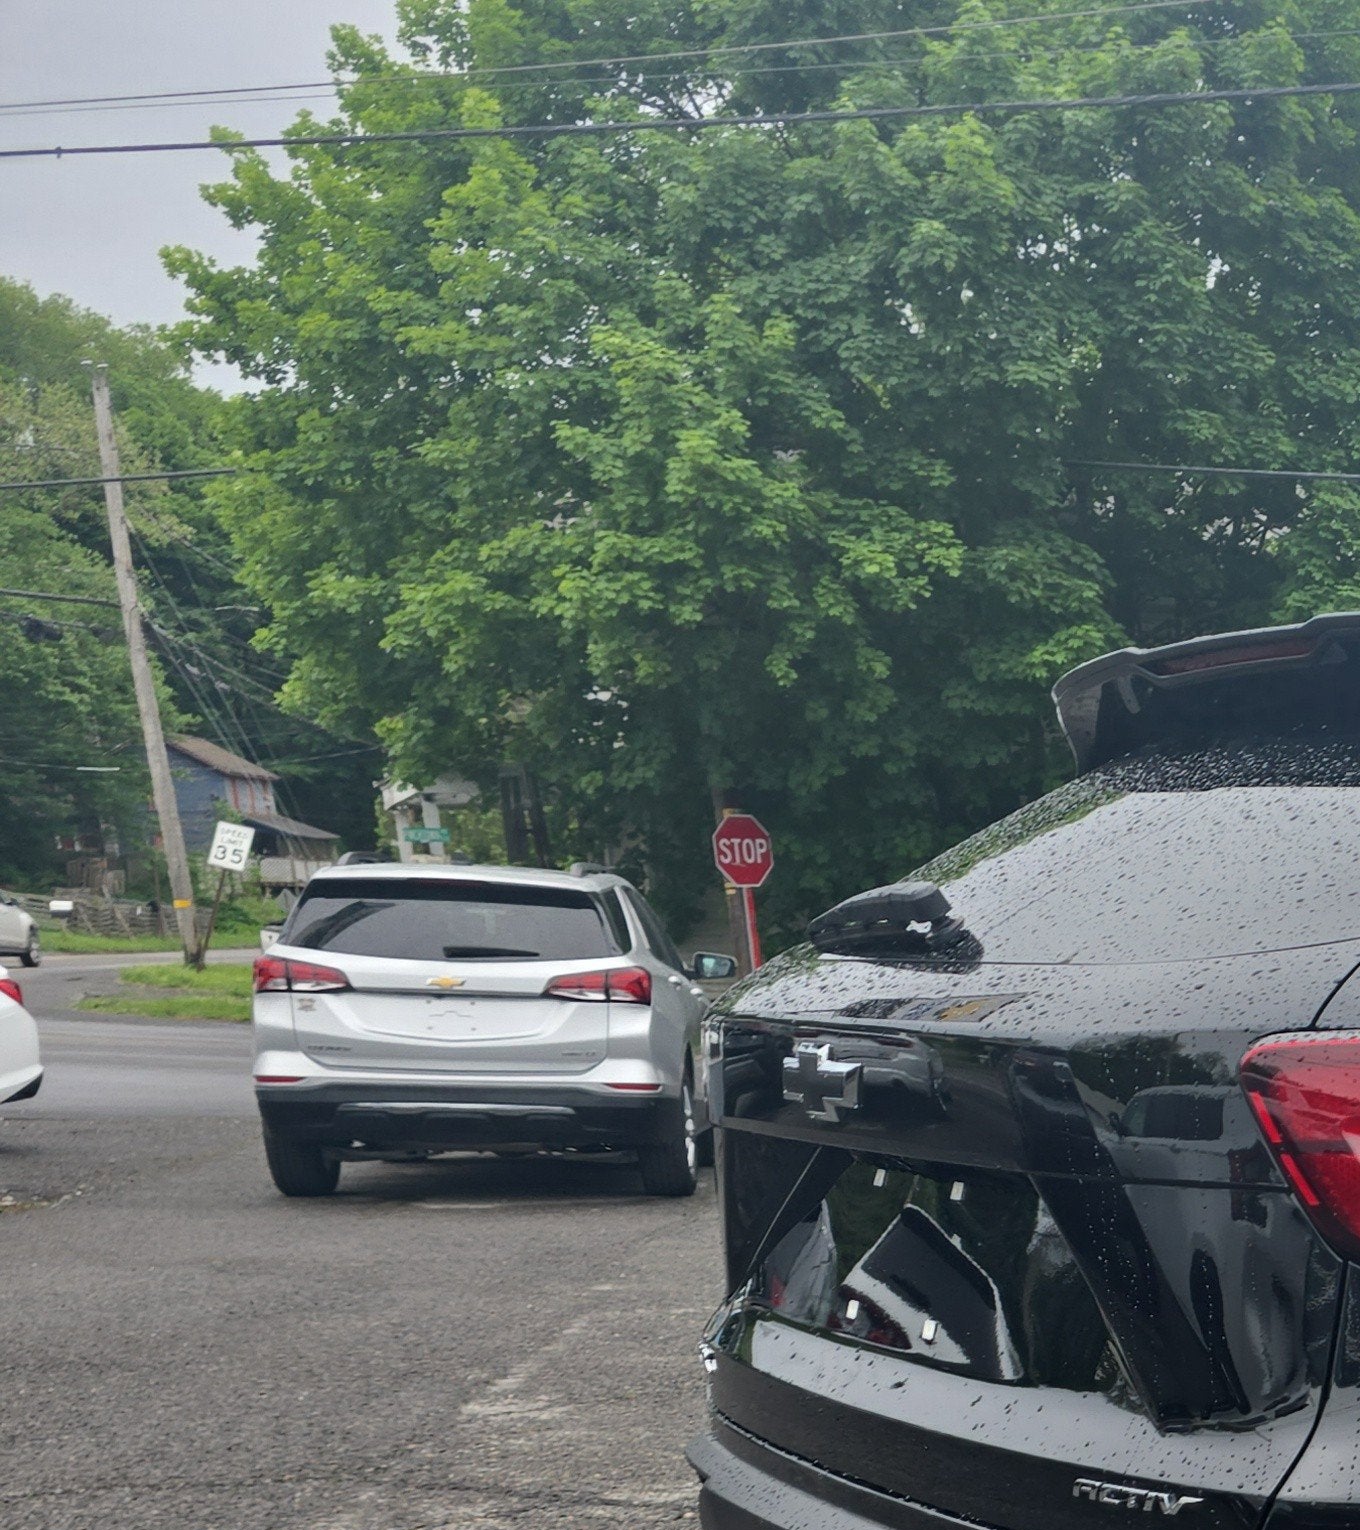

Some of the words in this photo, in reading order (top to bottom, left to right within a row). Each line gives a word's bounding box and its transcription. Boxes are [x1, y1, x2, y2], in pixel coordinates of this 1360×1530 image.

[214, 845, 245, 864] 35
[719, 838, 768, 864] STOP
[1072, 1478, 1205, 1515] ACTIV
